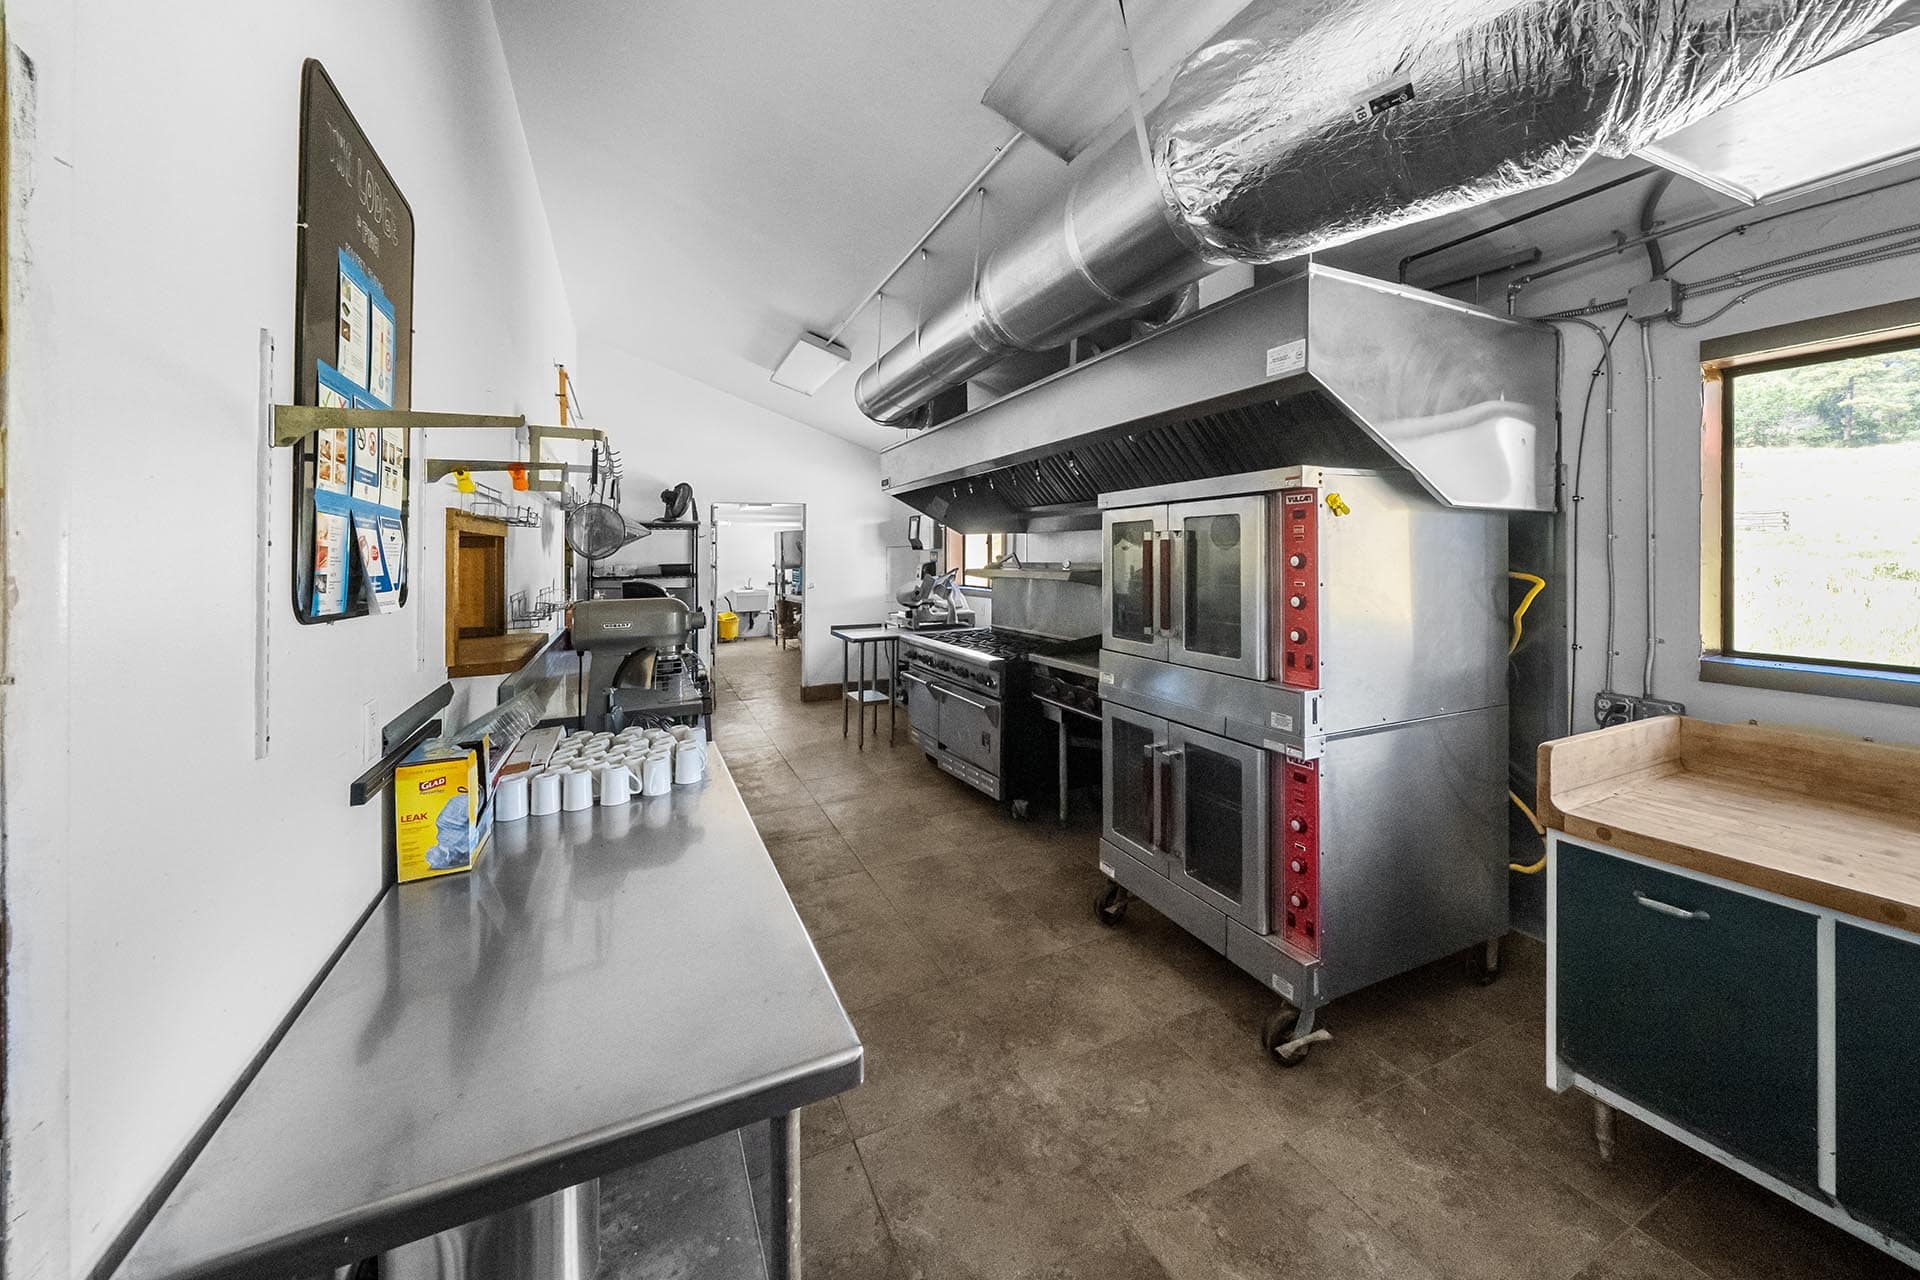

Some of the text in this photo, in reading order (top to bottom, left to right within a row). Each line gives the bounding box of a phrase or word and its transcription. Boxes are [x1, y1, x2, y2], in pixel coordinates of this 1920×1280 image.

[1355, 104, 1368, 121] 18
[1287, 494, 1312, 503] VULCAN
[420, 777, 446, 790] GLAD
[400, 812, 428, 823] LEAK
